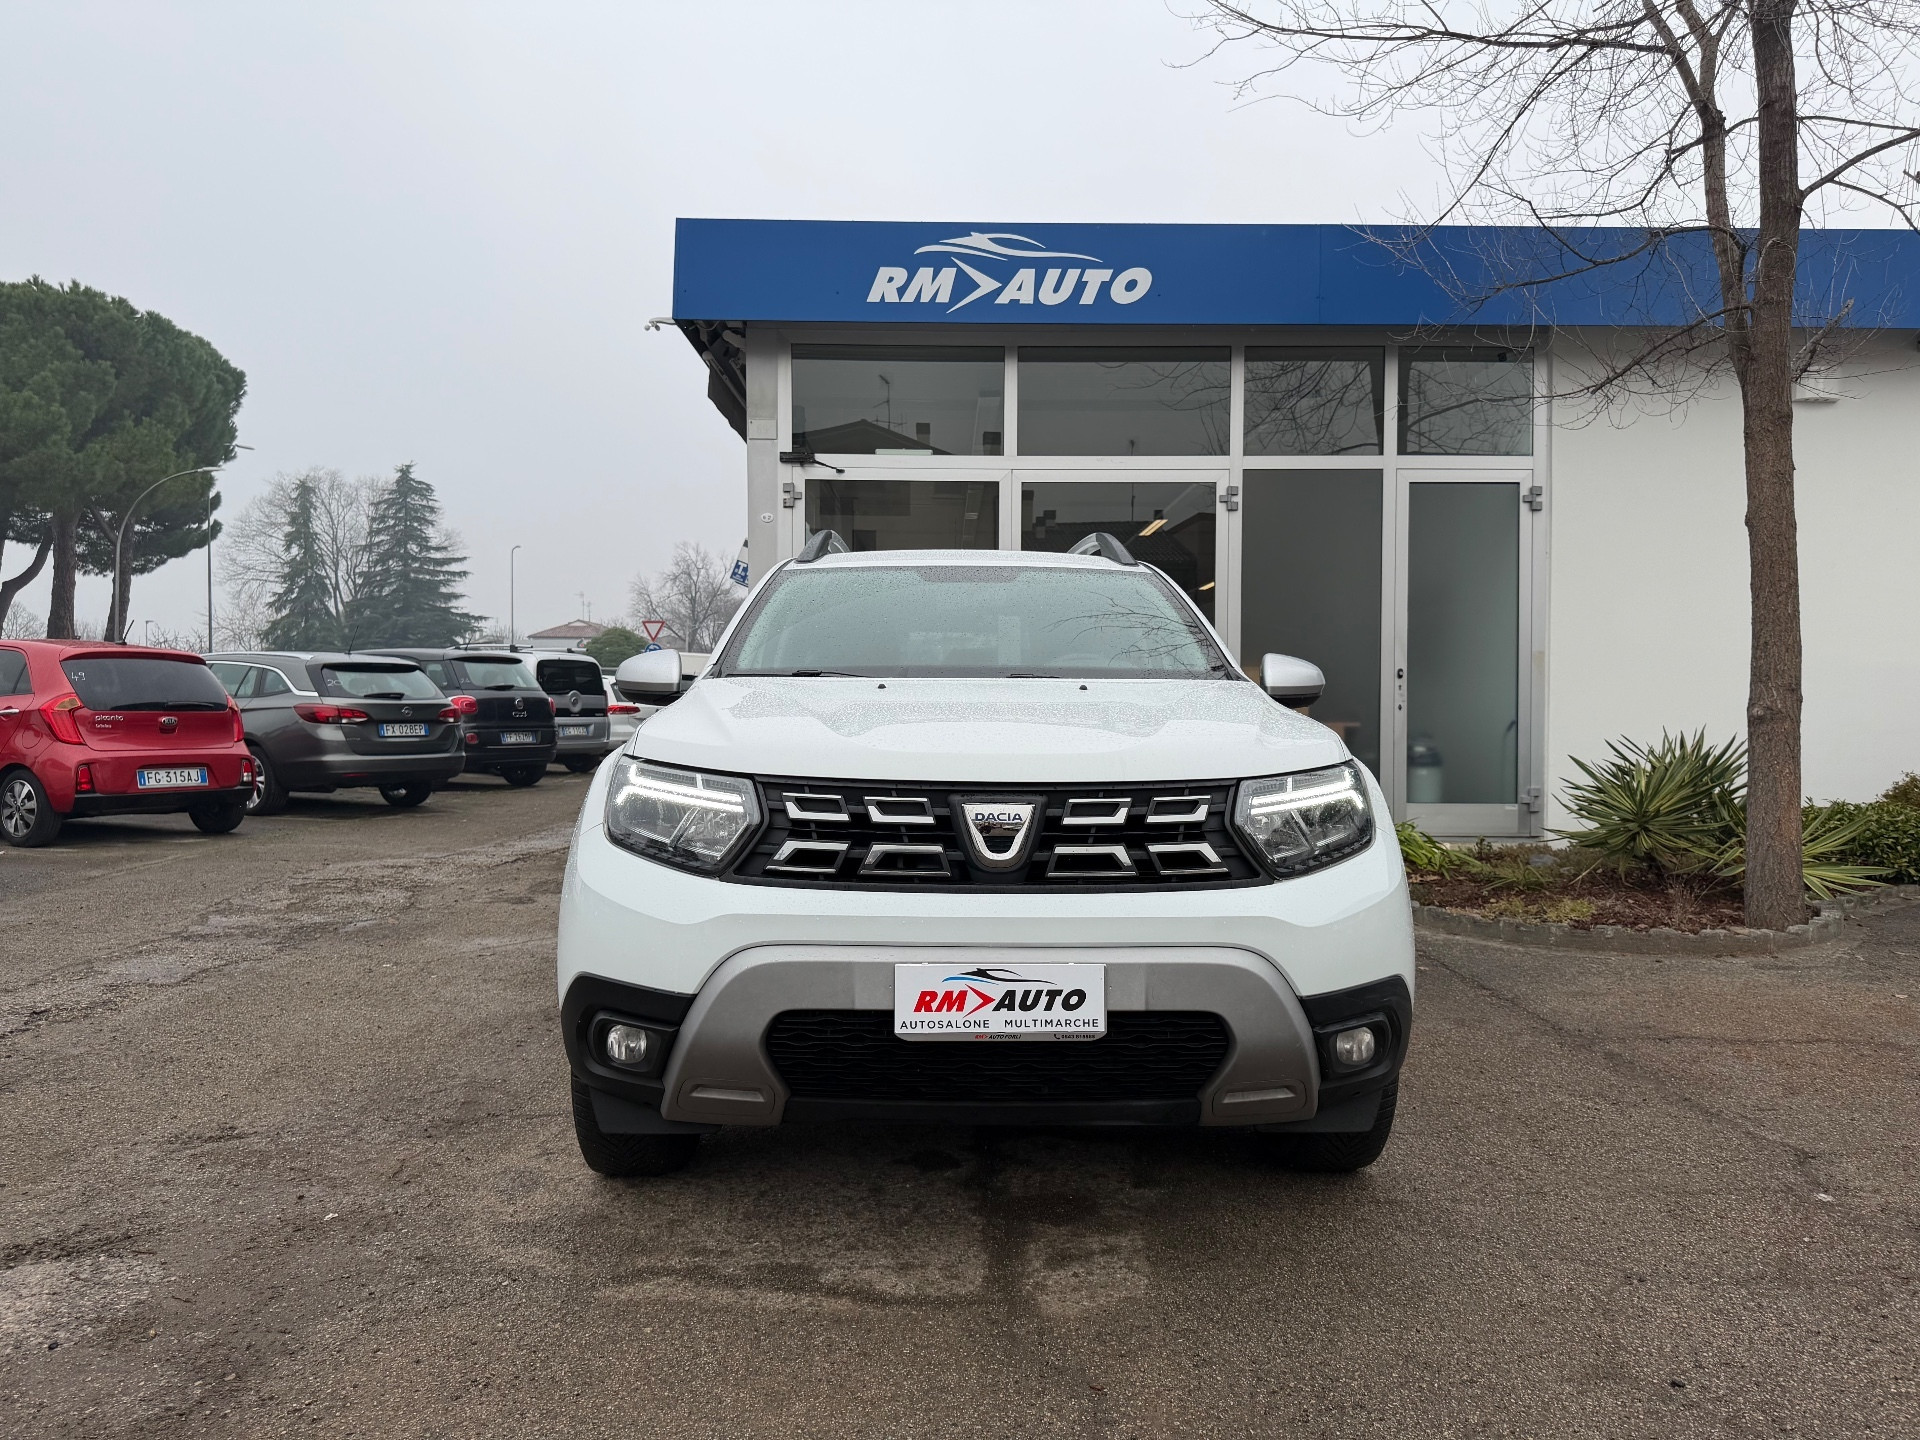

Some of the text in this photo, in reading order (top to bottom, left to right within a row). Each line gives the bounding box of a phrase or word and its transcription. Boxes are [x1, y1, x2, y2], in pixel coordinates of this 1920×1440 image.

[866, 267, 1153, 306] RM AUTO
[71, 671, 86, 682] 49
[146, 770, 200, 784] FG 315AJ
[975, 813, 1023, 822] DACIA
[913, 988, 1087, 1013] RM AUTO
[899, 1018, 1099, 1030] AUTOSALONE MULTIMARCHE
